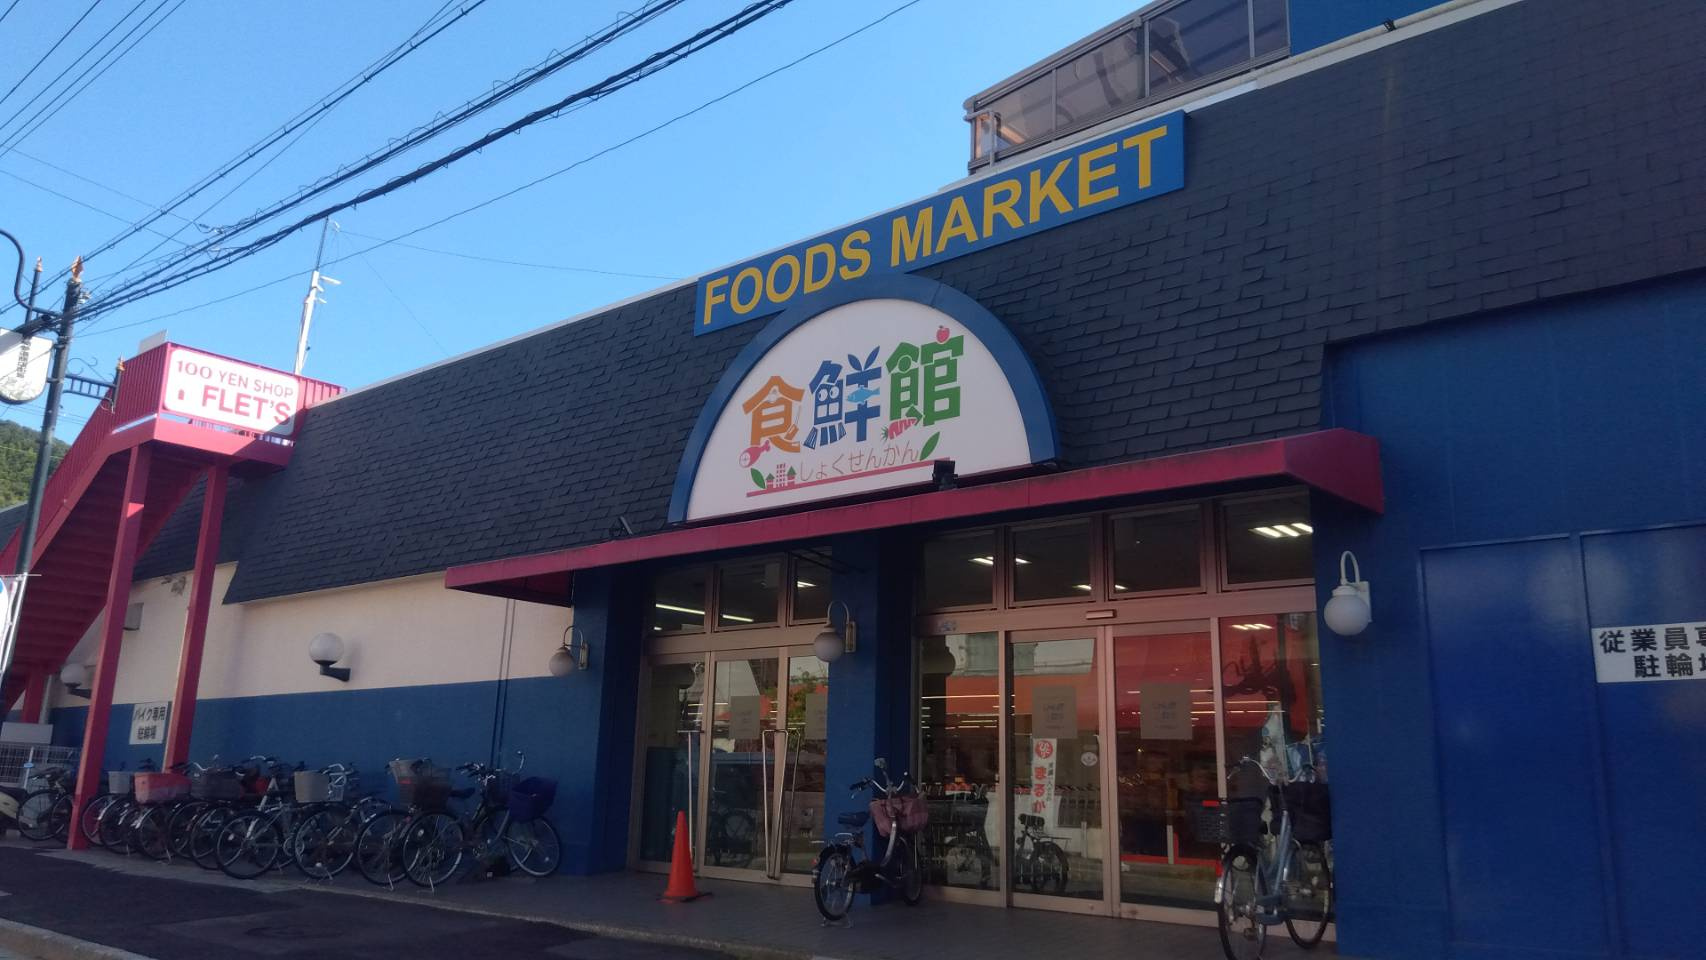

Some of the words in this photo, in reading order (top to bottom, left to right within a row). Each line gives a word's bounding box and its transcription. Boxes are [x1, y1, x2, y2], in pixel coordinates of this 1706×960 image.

[703, 229, 872, 325] FOODS
[889, 125, 1168, 268] MARKET
[177, 360, 213, 380] 100
[219, 370, 249, 389] YEN
[253, 379, 294, 398] SHOP
[742, 335, 965, 454] 食鮮館
[201, 384, 291, 425] FLET'S
[799, 440, 919, 483] しょくせんかん
